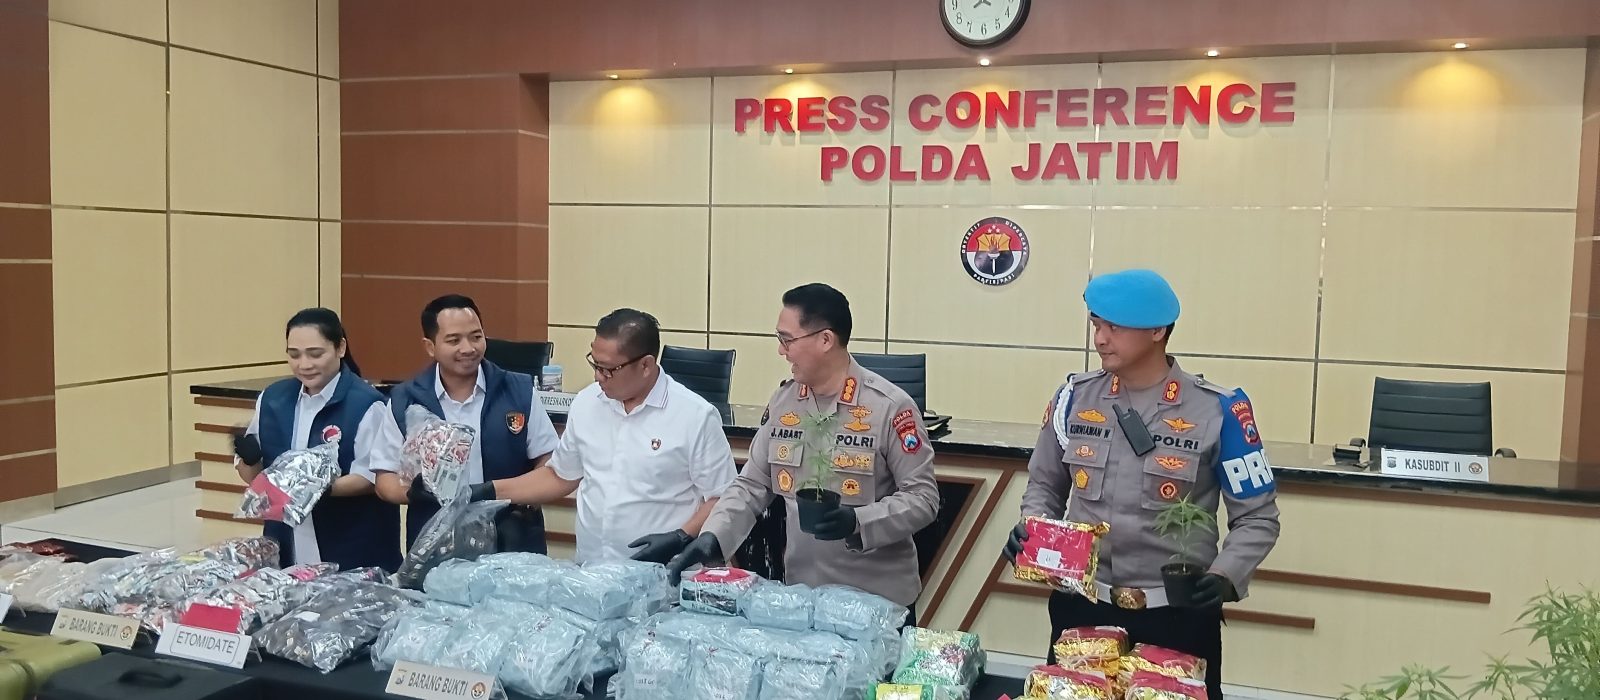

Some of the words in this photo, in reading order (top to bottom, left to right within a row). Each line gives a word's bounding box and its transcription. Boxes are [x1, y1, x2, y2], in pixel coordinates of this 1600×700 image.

[956, 12, 962, 24] 8
[1005, 6, 1010, 18] 4
[967, 21, 973, 33] 7
[981, 23, 987, 36] 6
[995, 18, 1001, 30] 5
[734, 94, 890, 133] PRESS
[908, 82, 1296, 131] CONFERENCE
[820, 144, 991, 182] POLDA
[1011, 141, 1179, 181] JATIM
[835, 434, 874, 448] POLRI
[1153, 434, 1199, 450] POLRI
[1404, 458, 1449, 472] KASUBDIT
[69, 617, 98, 634] BARANG
[96, 622, 118, 637] BUKTI
[176, 630, 236, 654] ETOMIDATE
[407, 672, 442, 692] BARANG
[441, 678, 469, 697] BUKTI
